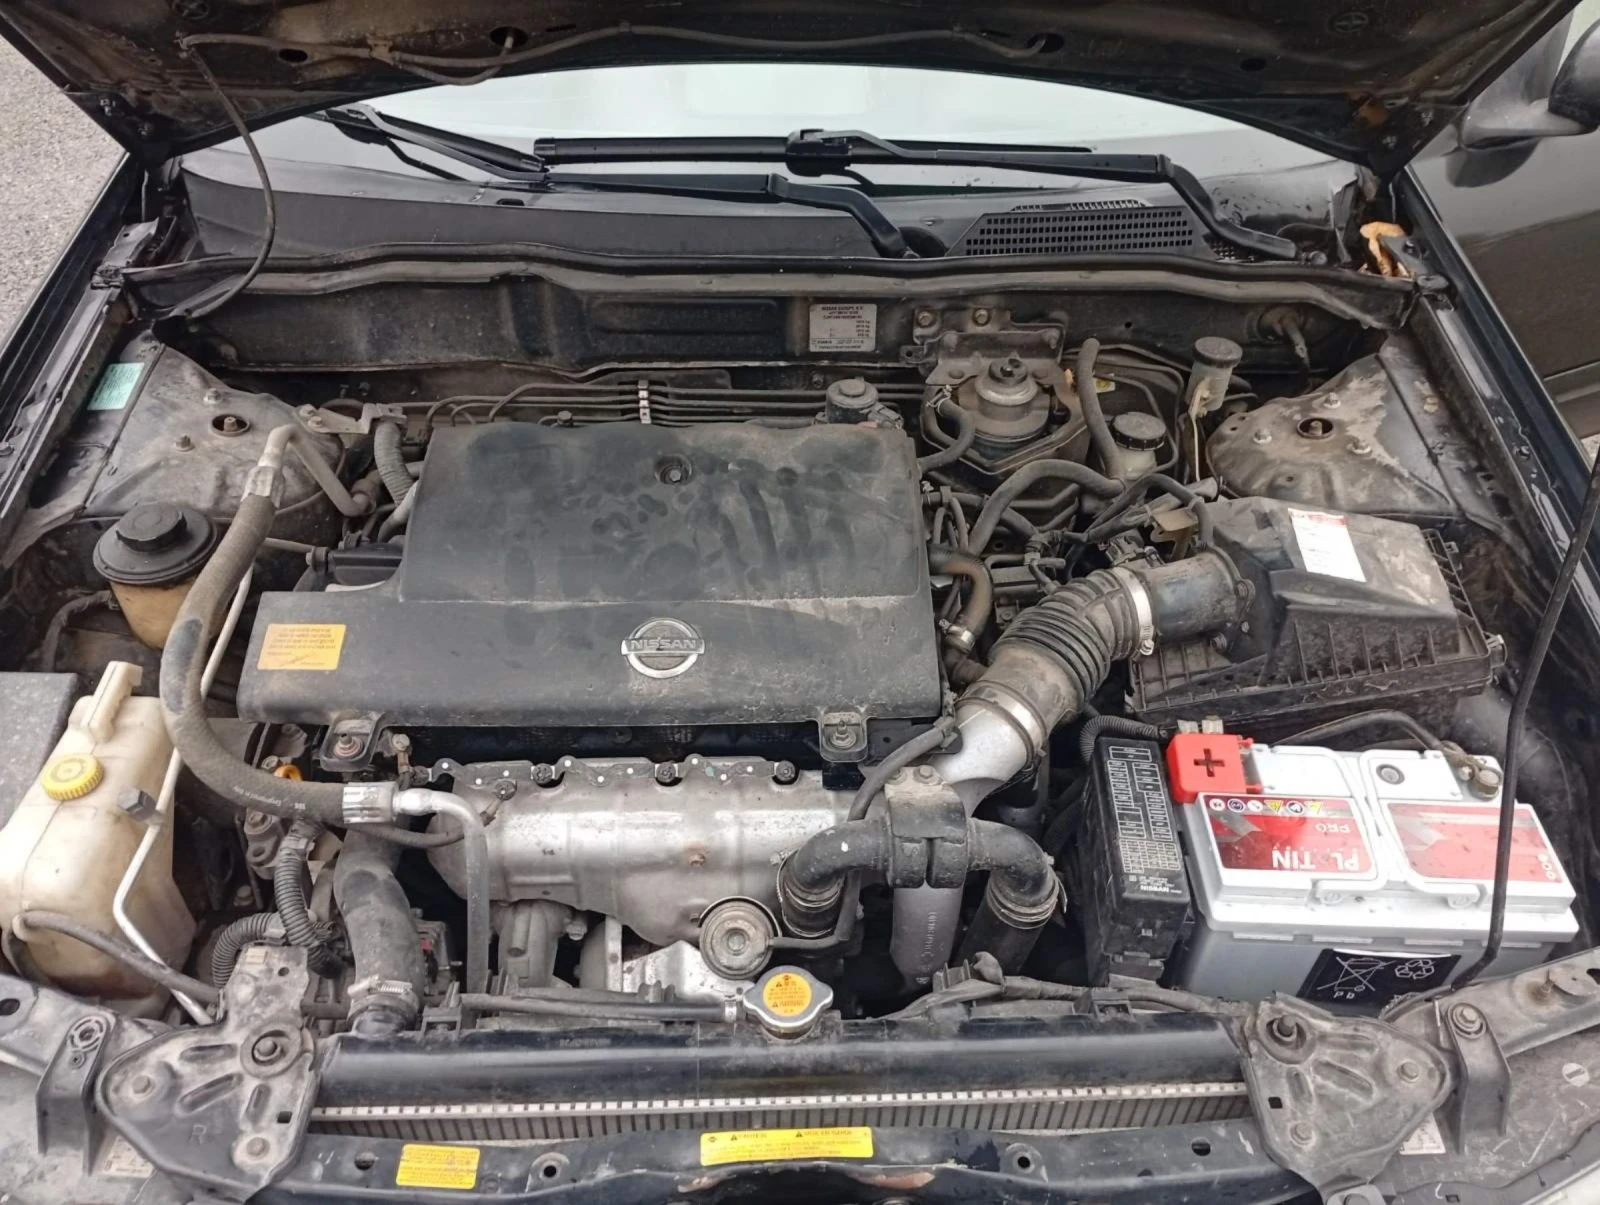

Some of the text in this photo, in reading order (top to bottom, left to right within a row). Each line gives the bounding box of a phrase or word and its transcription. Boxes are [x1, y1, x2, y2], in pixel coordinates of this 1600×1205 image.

[630, 639, 696, 650] NISSAN
[1314, 823, 1350, 833] PRO
[1271, 849, 1360, 871] PLTIN
